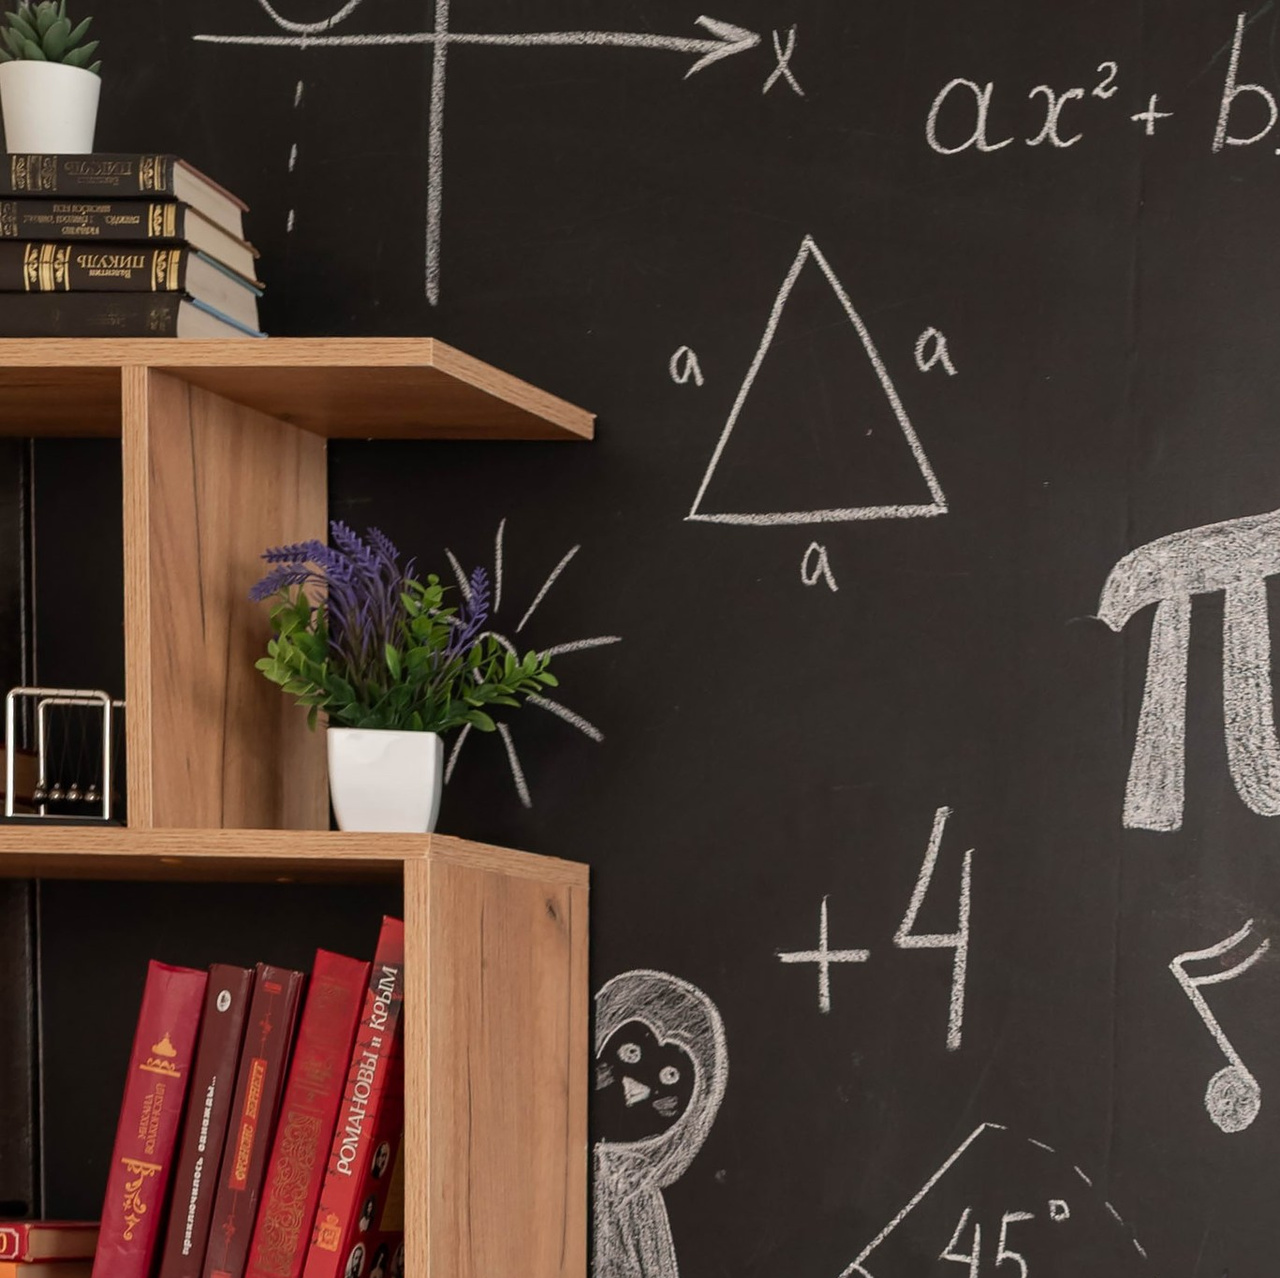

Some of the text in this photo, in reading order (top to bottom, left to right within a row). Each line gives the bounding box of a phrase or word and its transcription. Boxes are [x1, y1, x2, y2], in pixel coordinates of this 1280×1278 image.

[76, 255, 146, 269] ПИКУЛЬ
[669, 345, 704, 387] a
[913, 326, 959, 376] a
[800, 541, 839, 593] a
[336, 1050, 379, 1178] РОМАНОВЫ
[369, 964, 399, 1032] КРЫМ
